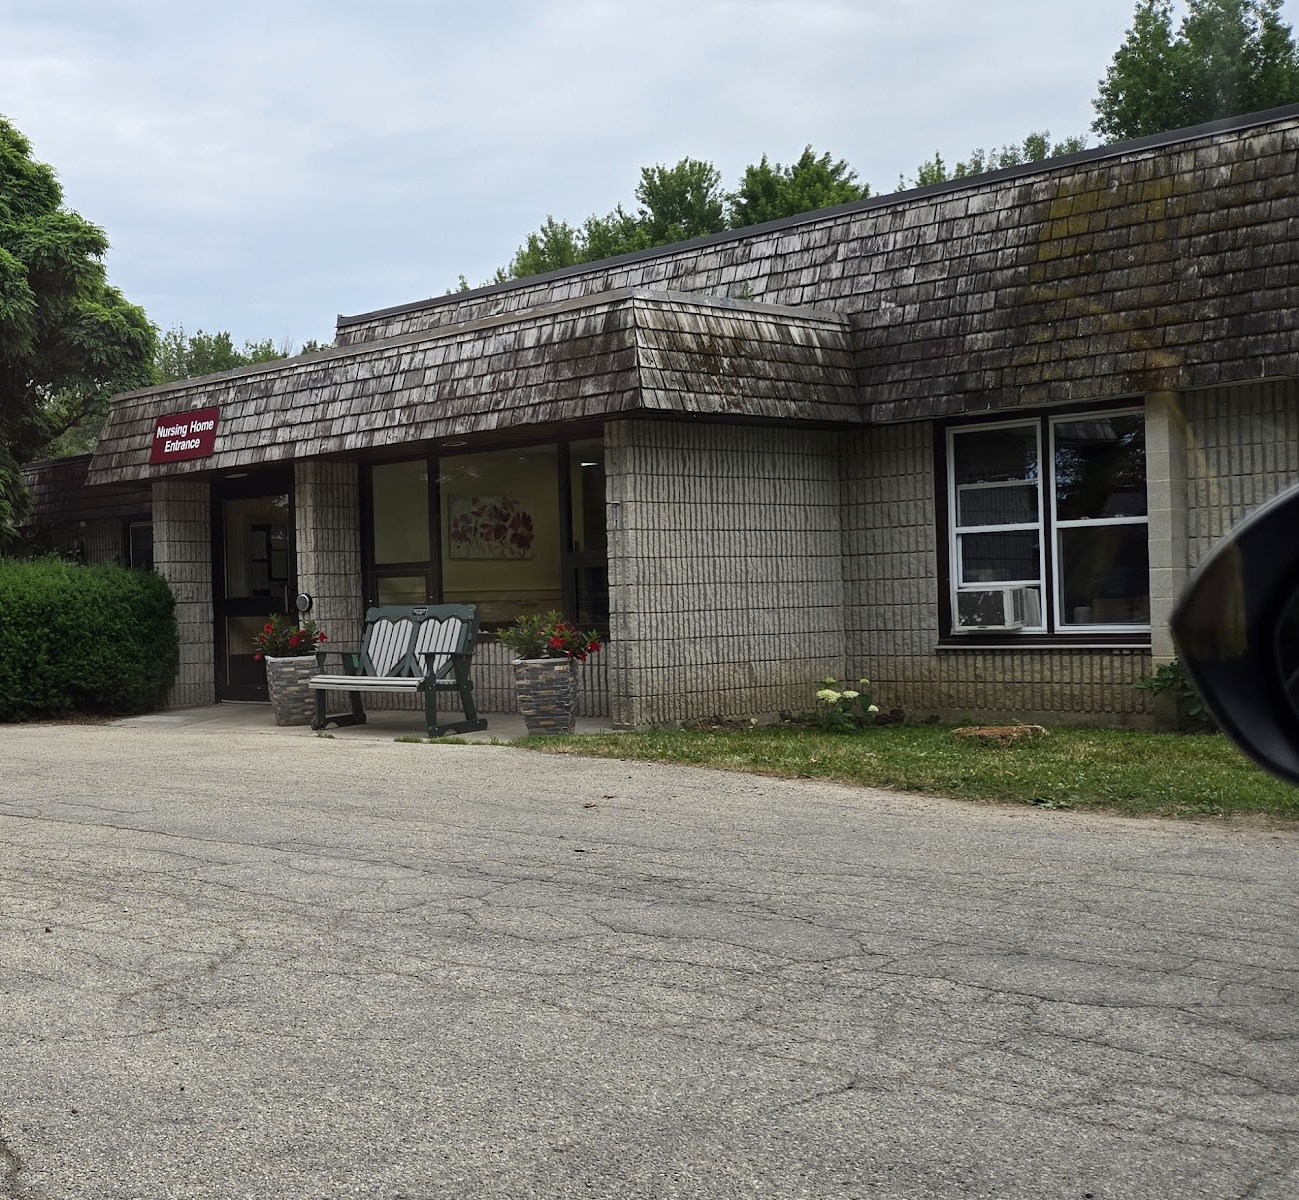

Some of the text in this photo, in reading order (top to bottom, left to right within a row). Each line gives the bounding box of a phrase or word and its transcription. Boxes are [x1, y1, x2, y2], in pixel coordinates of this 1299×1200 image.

[156, 420, 214, 438] Nursing Home
[164, 438, 200, 453] Entrance
